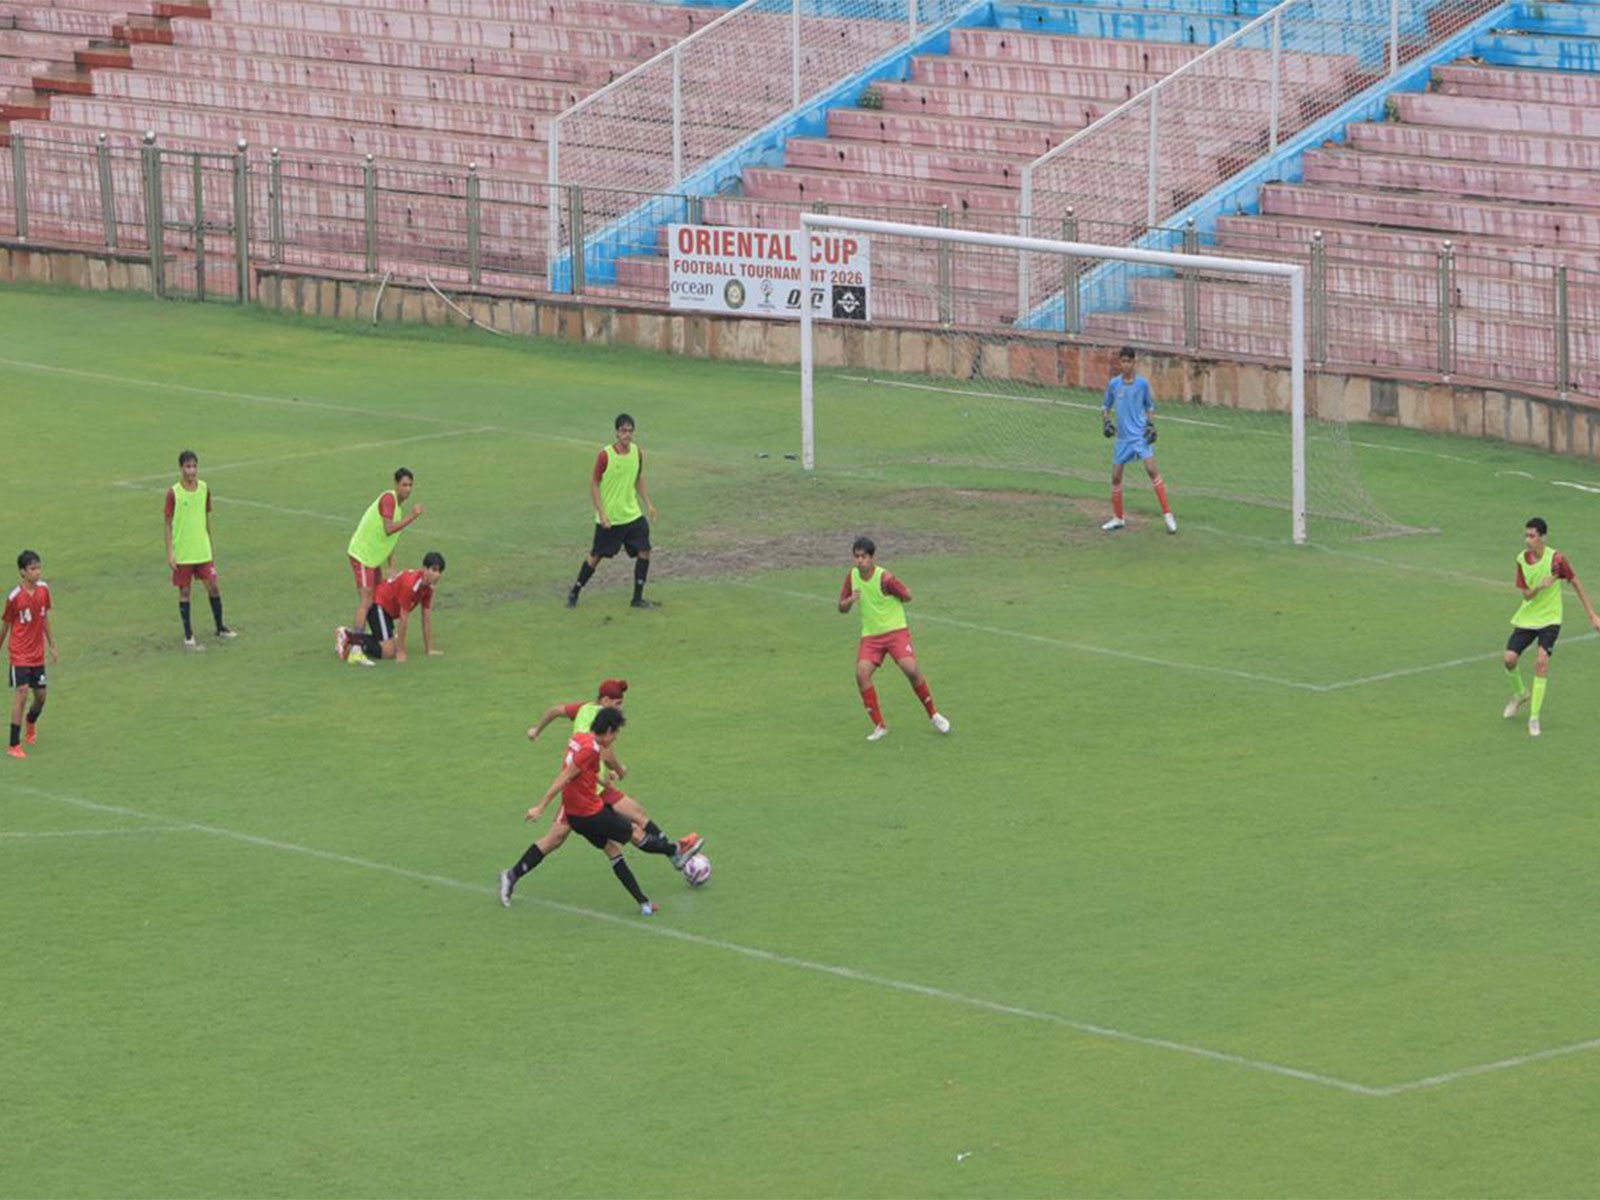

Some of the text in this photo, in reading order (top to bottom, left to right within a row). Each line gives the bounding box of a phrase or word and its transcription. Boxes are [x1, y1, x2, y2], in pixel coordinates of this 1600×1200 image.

[678, 228, 858, 265] ORIENTAL CUP
[673, 260, 863, 285] FOOTBALL TOURNAMNT 2026
